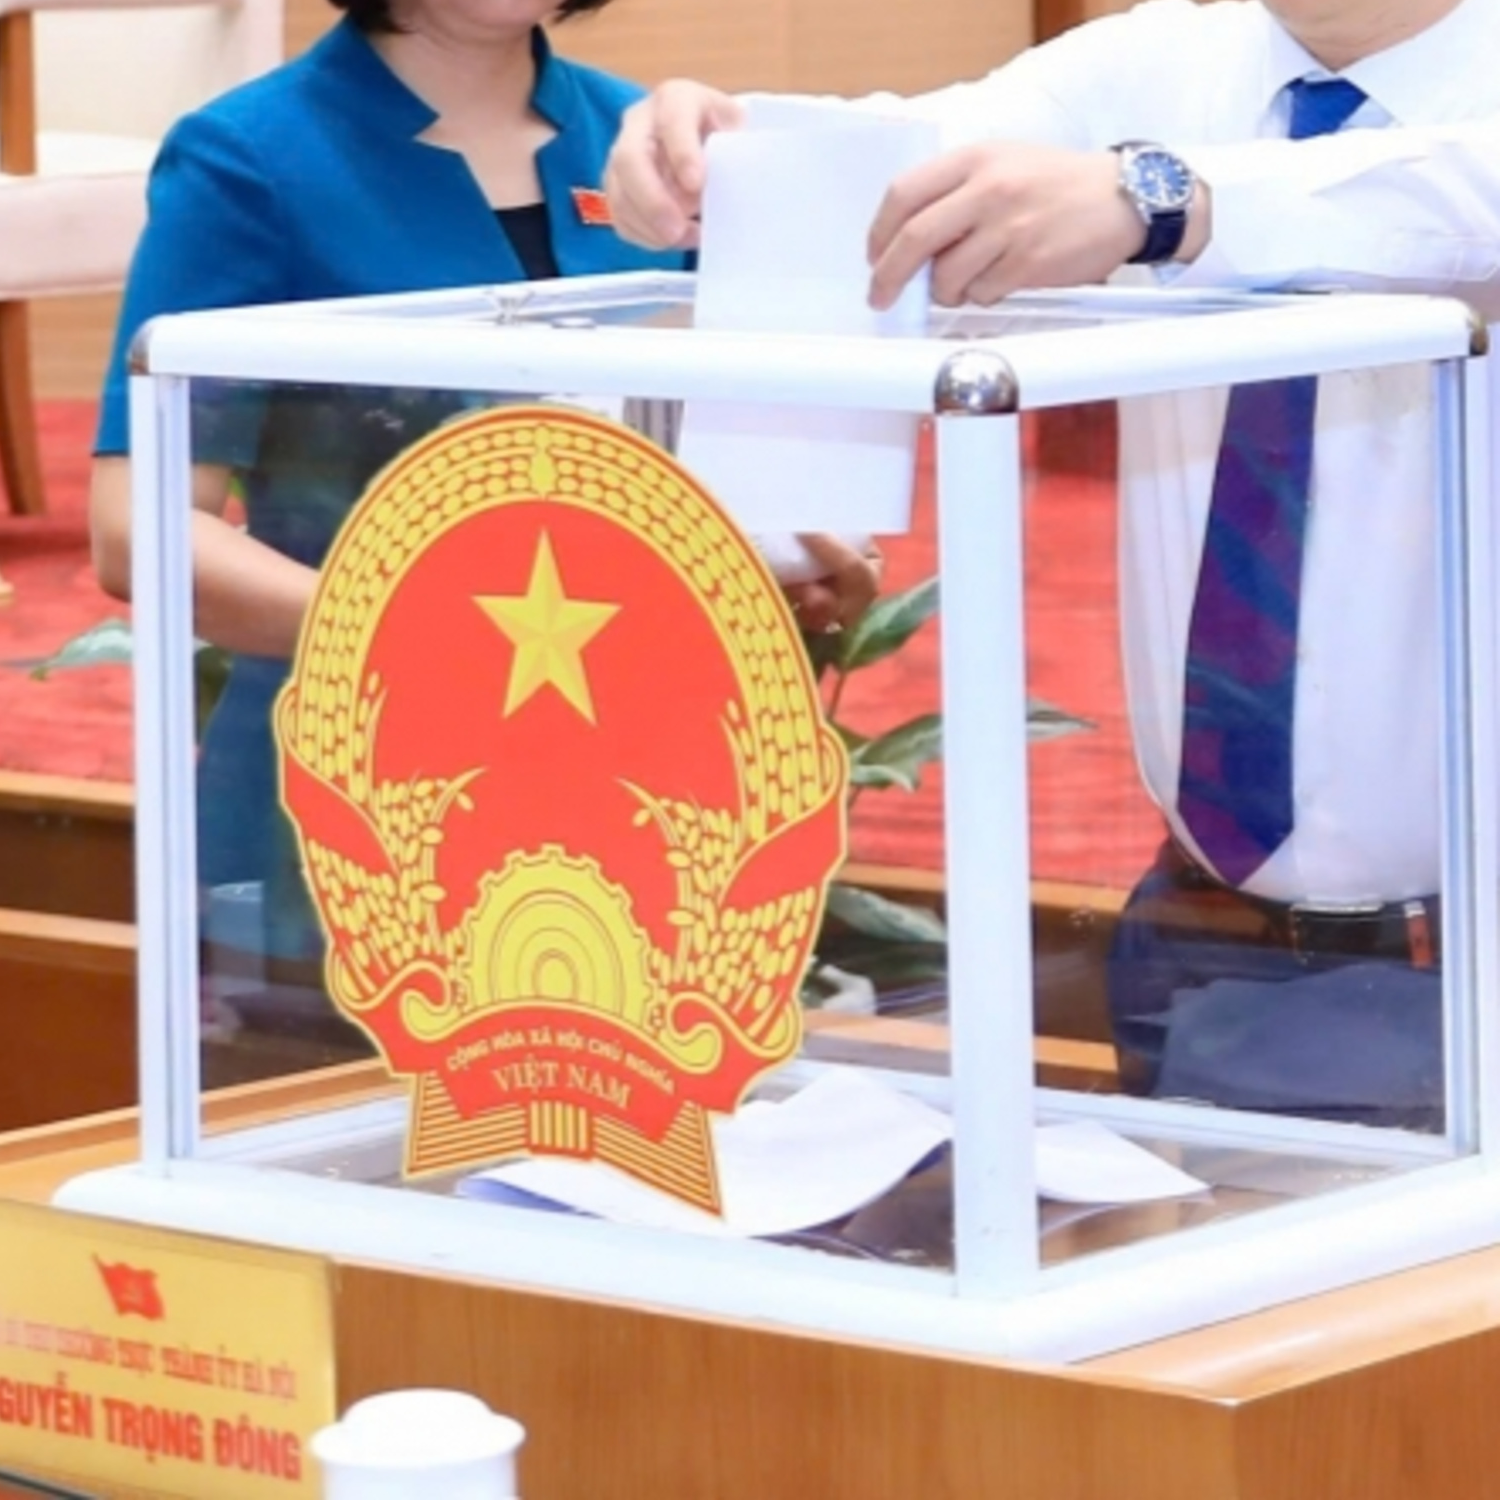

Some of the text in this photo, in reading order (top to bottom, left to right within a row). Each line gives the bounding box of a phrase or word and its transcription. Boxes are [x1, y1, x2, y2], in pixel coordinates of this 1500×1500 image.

[492, 1053, 631, 1110] VIỆT NAM
[101, 1397, 204, 1463] TRỌNG
[212, 1412, 301, 1481] ĐÔNG
